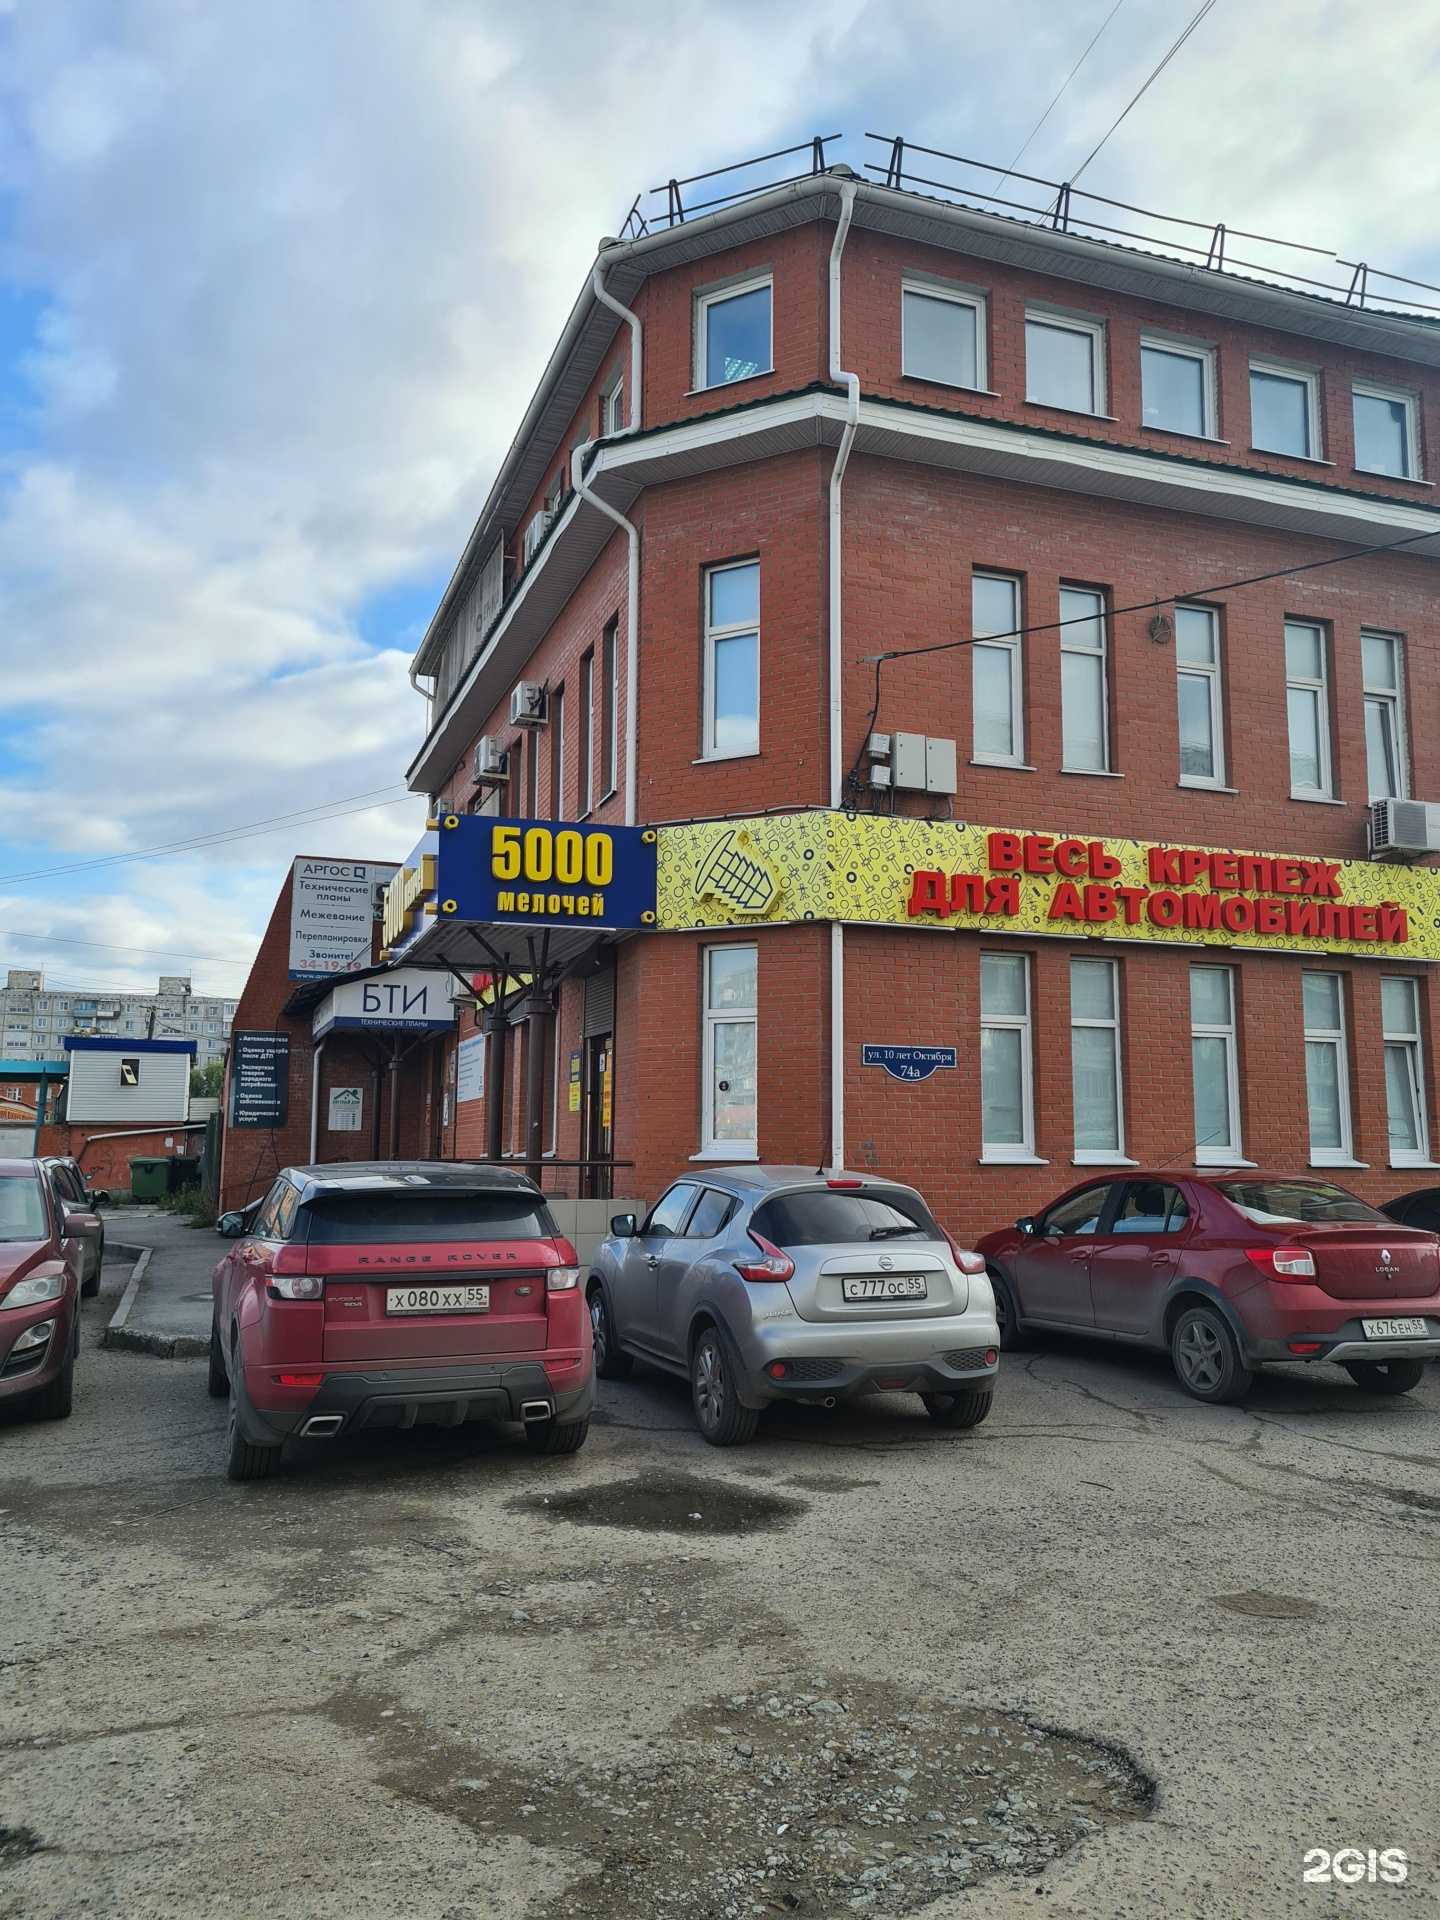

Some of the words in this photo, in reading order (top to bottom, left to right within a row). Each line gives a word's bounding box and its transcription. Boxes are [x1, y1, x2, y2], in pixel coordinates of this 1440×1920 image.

[491, 826, 613, 886] 5000
[303, 864, 350, 877] АРГОС
[988, 832, 1122, 880] ВЕСЬ
[1147, 846, 1344, 898] КРЕПЕЖ
[300, 881, 369, 895] Технические
[316, 893, 351, 903] планы
[496, 892, 605, 917] мелочей
[907, 869, 1021, 918] ДЛЯ
[1048, 882, 1409, 943] АВТОМОБИЛЕЙ
[300, 909, 366, 922] Межевание
[295, 930, 368, 945] Перепланировки
[309, 949, 354, 960] Звоните!
[300, 960, 362, 972] 34-19-19
[363, 983, 428, 1015] БТИ
[360, 1018, 403, 1027] ТЕХНИЧЕСКИЕ
[868, 1051, 881, 1060] ул.
[884, 1050, 894, 1059] 10
[896, 1052, 911, 1060] лет
[913, 1051, 952, 1064] Октября
[900, 1065, 920, 1077] 74а
[358, 1256, 432, 1264] RANGE
[447, 1252, 518, 1261] ROVER
